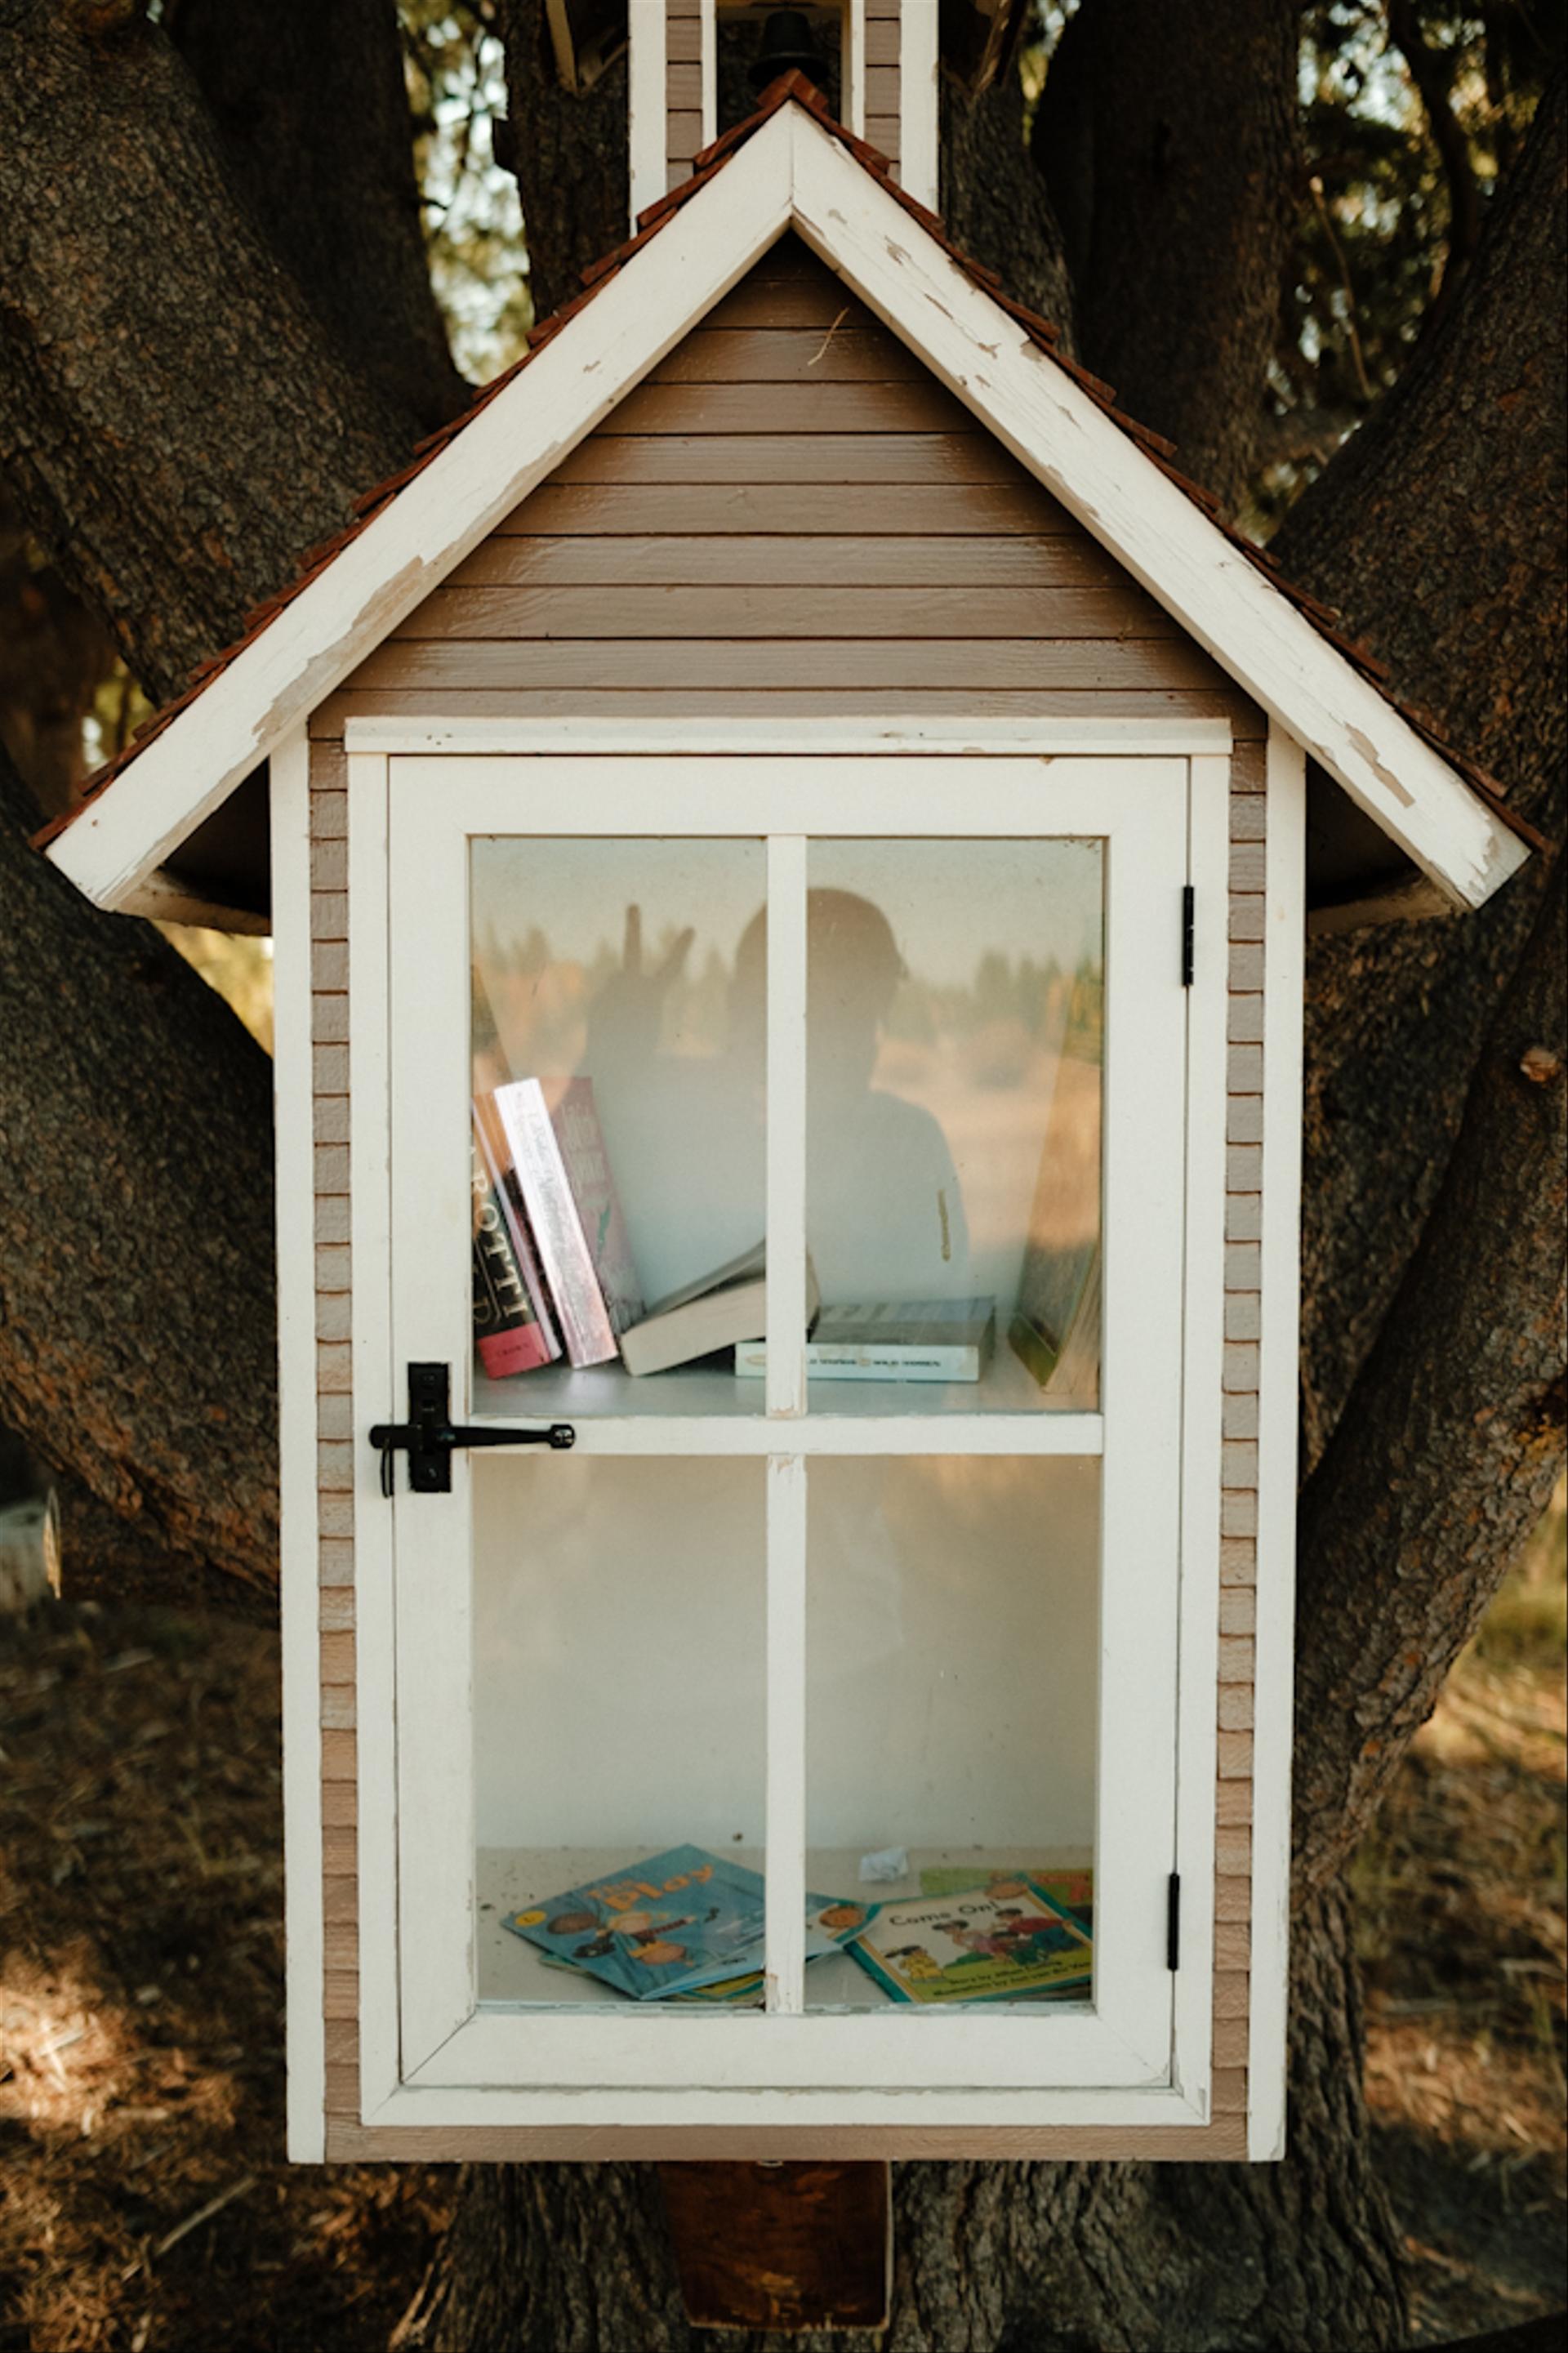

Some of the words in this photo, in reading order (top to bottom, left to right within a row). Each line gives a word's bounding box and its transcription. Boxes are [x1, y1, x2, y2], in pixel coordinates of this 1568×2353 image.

[604, 1864, 714, 1912] Play
[889, 1911, 952, 1927] Come
[958, 1900, 1001, 1915] On!
